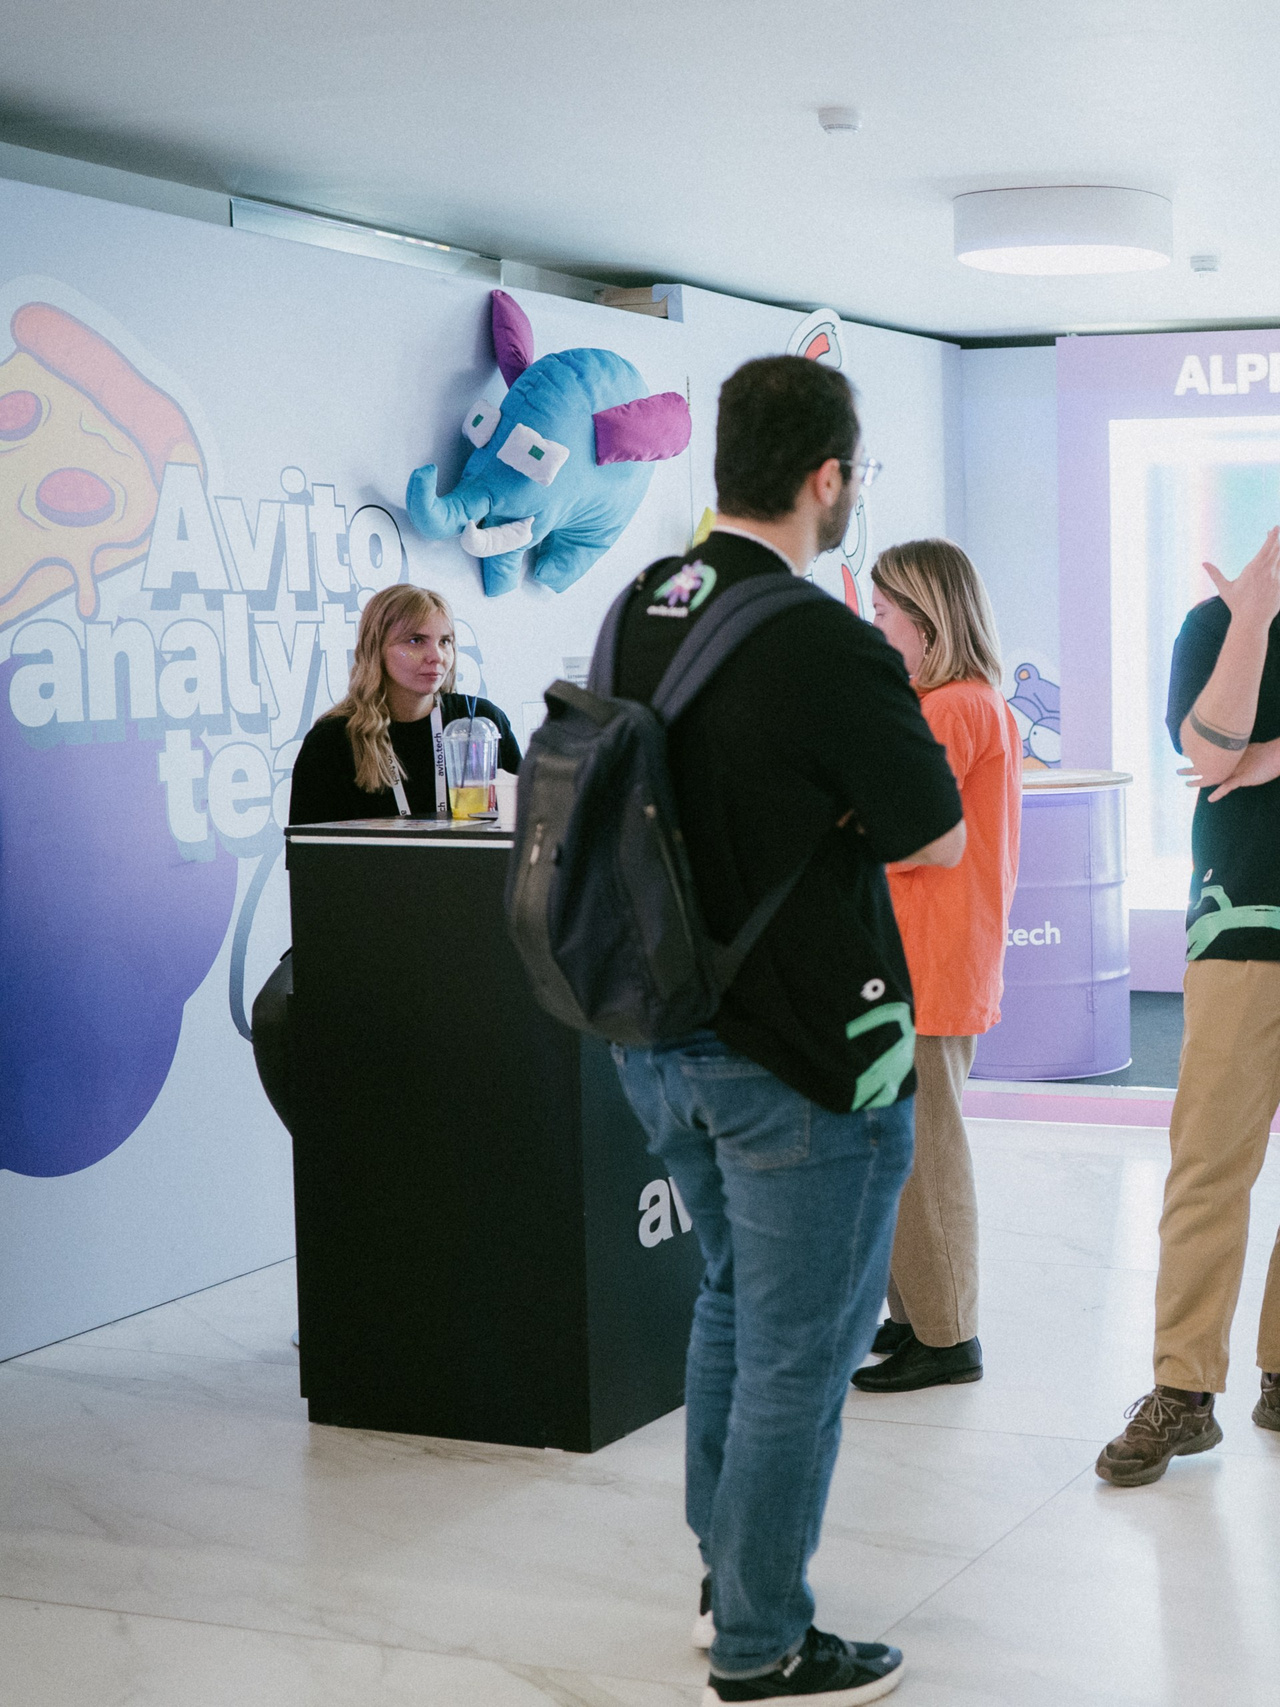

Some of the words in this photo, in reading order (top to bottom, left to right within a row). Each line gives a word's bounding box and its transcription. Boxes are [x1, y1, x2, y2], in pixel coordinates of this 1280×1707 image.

[140, 463, 405, 596] Avito
[9, 593, 485, 748] analyts
[434, 732, 444, 777] avito.tech
